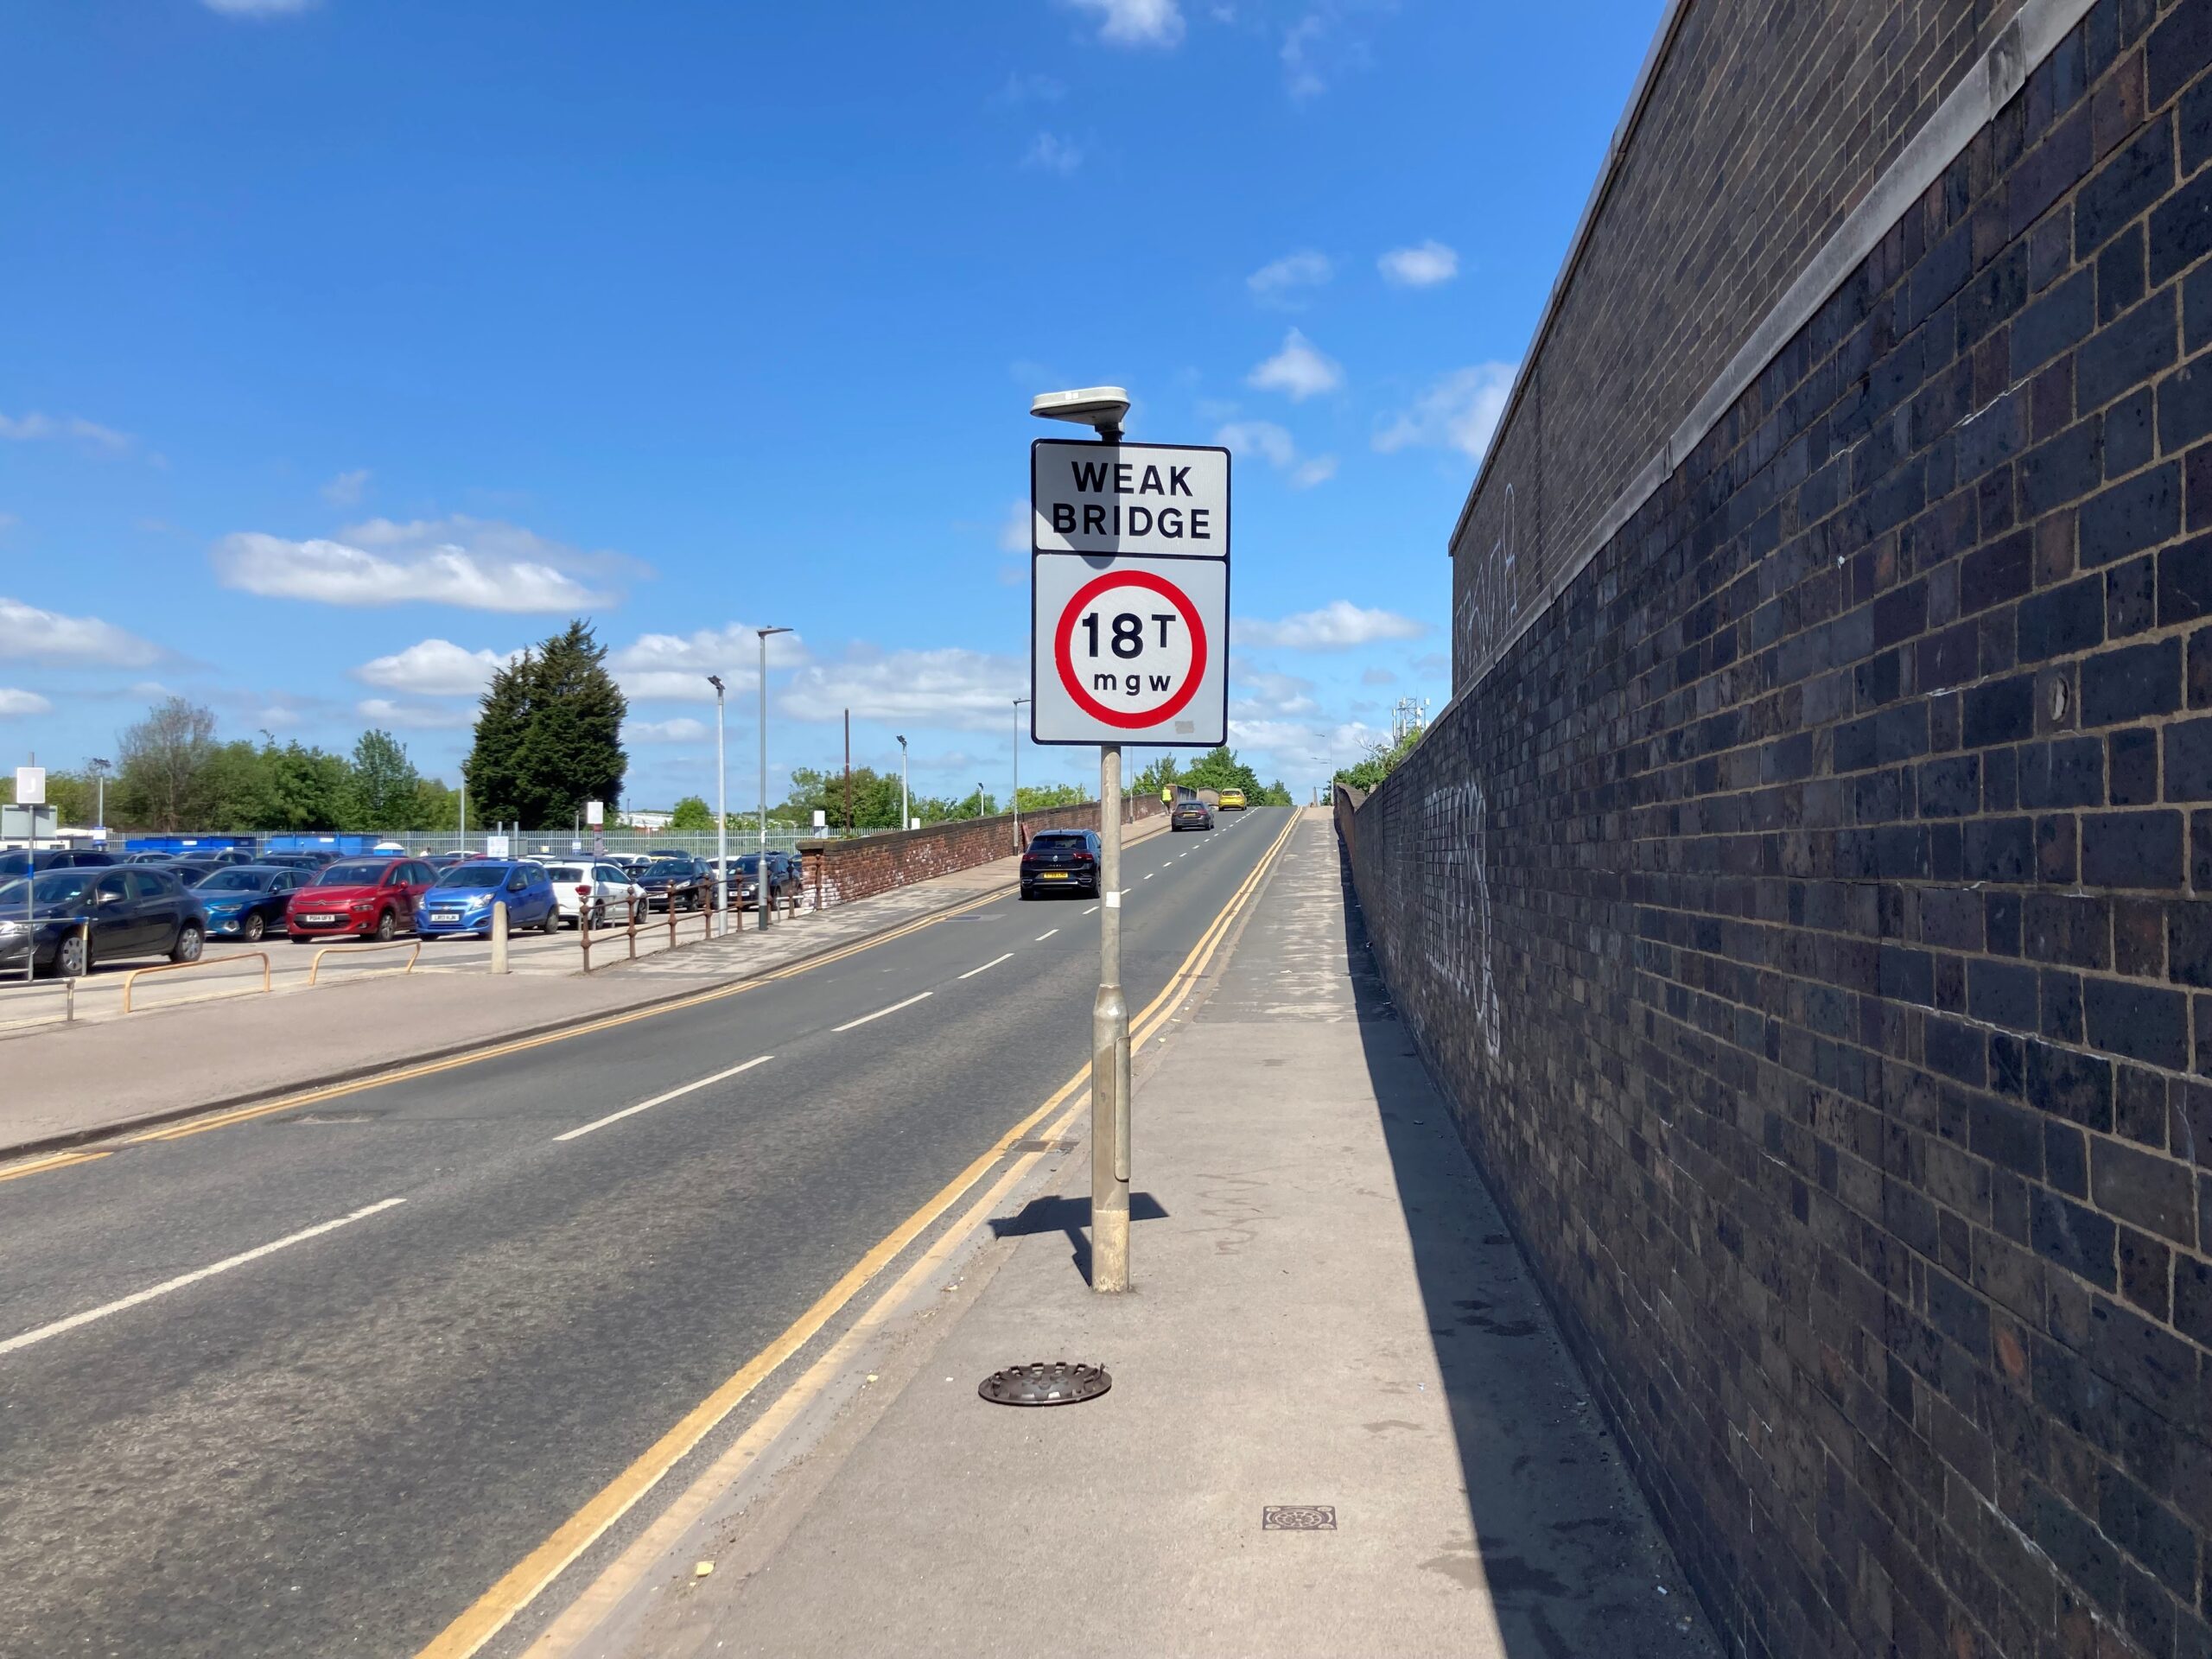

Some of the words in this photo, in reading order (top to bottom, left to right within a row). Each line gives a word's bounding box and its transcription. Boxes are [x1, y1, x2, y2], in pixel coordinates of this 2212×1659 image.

[1071, 461, 1194, 497] WEAK
[1052, 503, 1211, 539] BRIDGE
[1082, 613, 1177, 659] 18T
